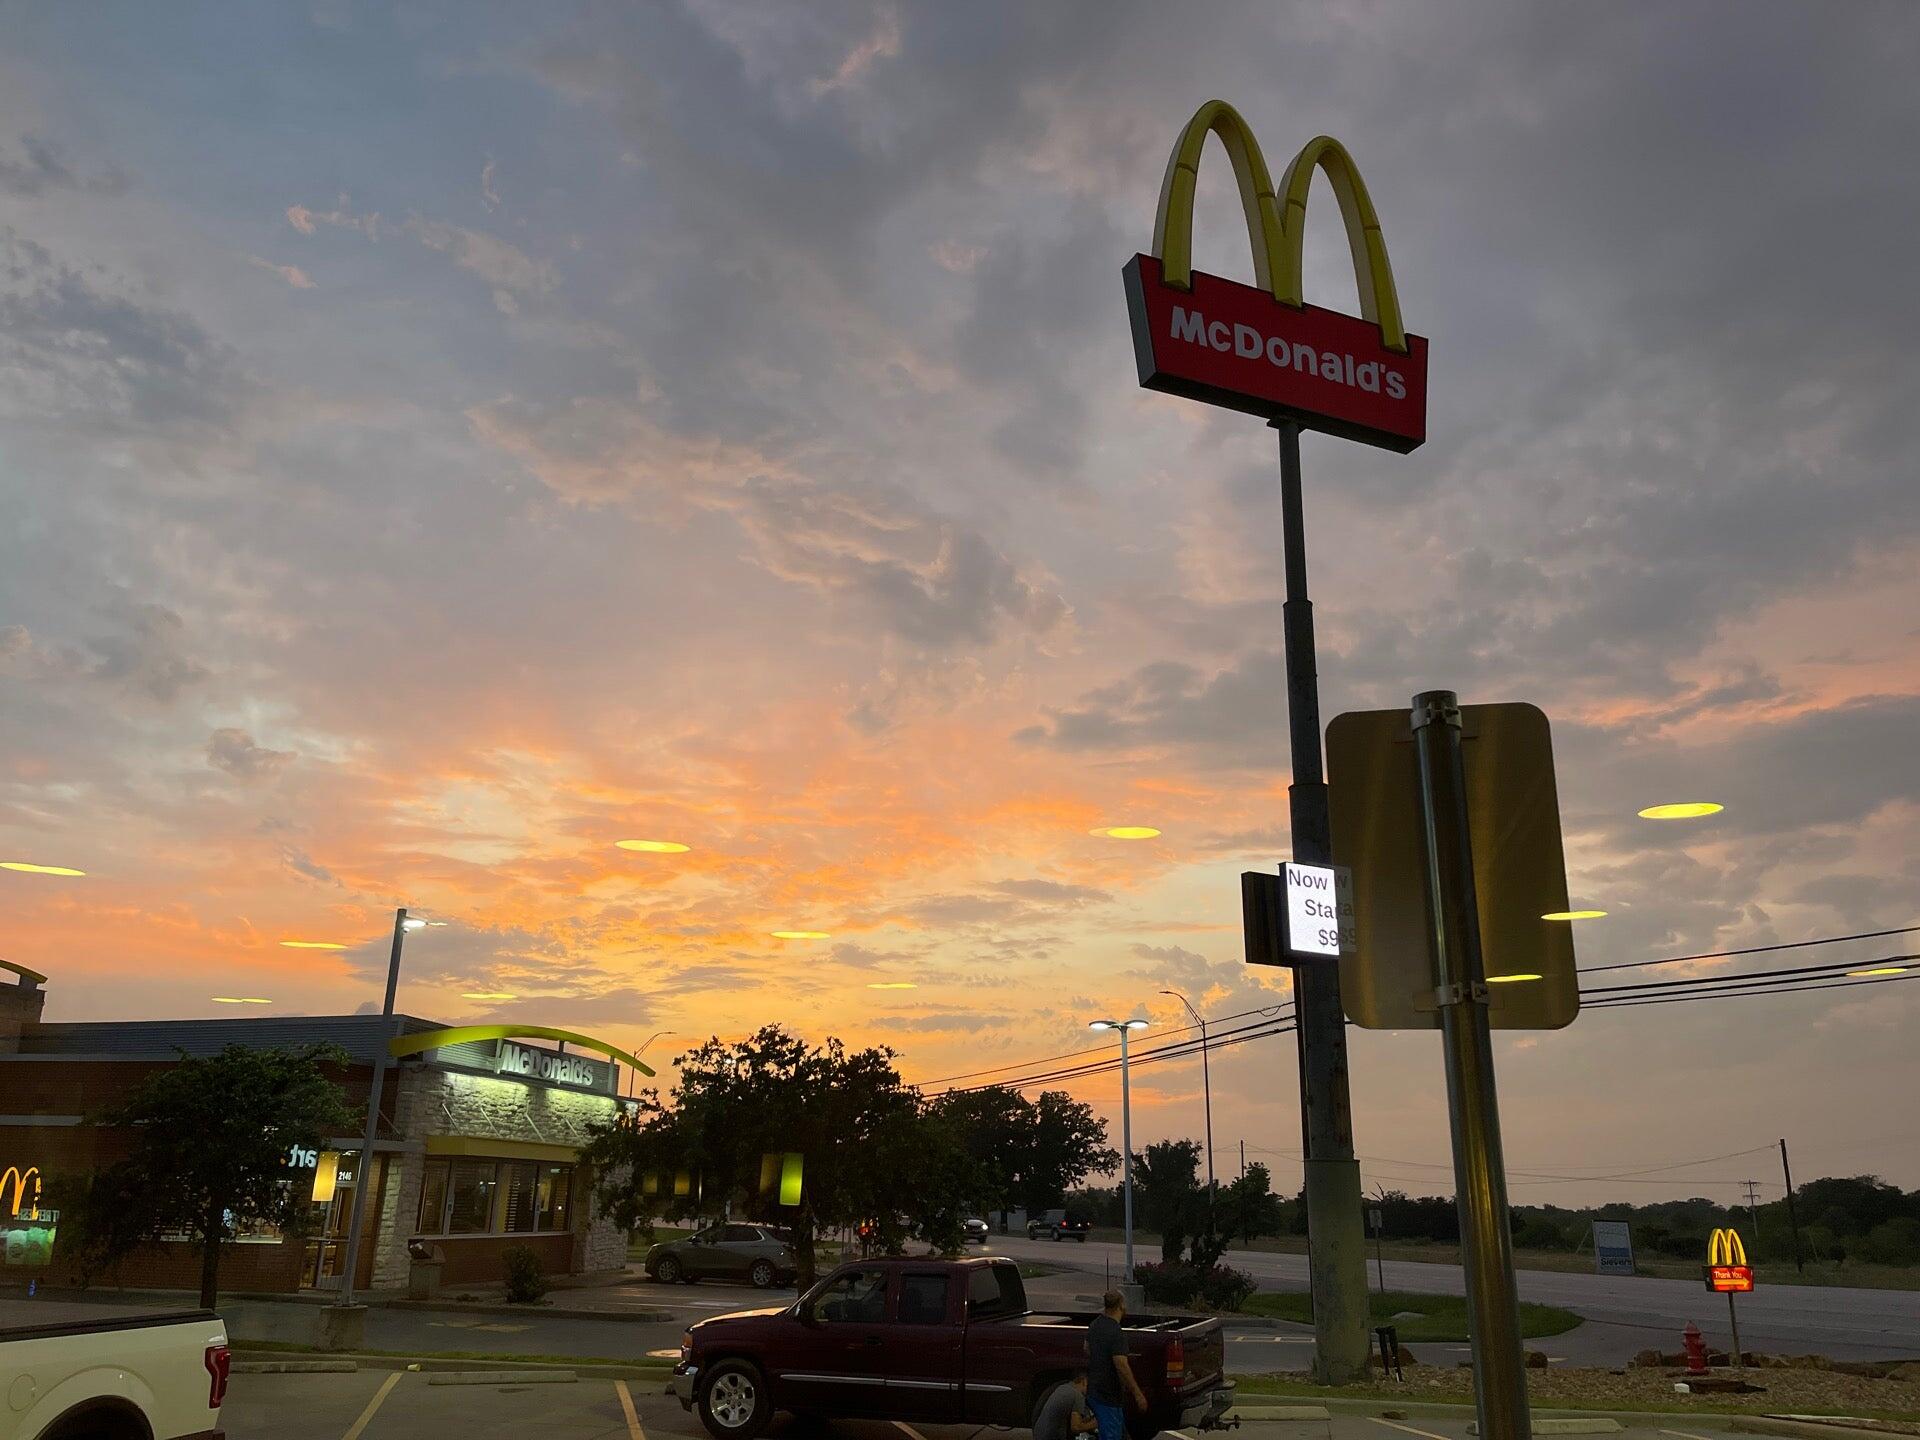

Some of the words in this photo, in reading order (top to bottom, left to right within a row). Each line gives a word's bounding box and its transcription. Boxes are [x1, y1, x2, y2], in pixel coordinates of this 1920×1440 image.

[1170, 305, 1407, 400] McDonald's
[1288, 868, 1328, 890] Now
[1304, 898, 1337, 920] Sta
[501, 1043, 594, 1086] McDonald's
[338, 1171, 352, 1181] 2146
[1714, 1271, 1731, 1279] Thank
[1731, 1271, 1742, 1279] You
